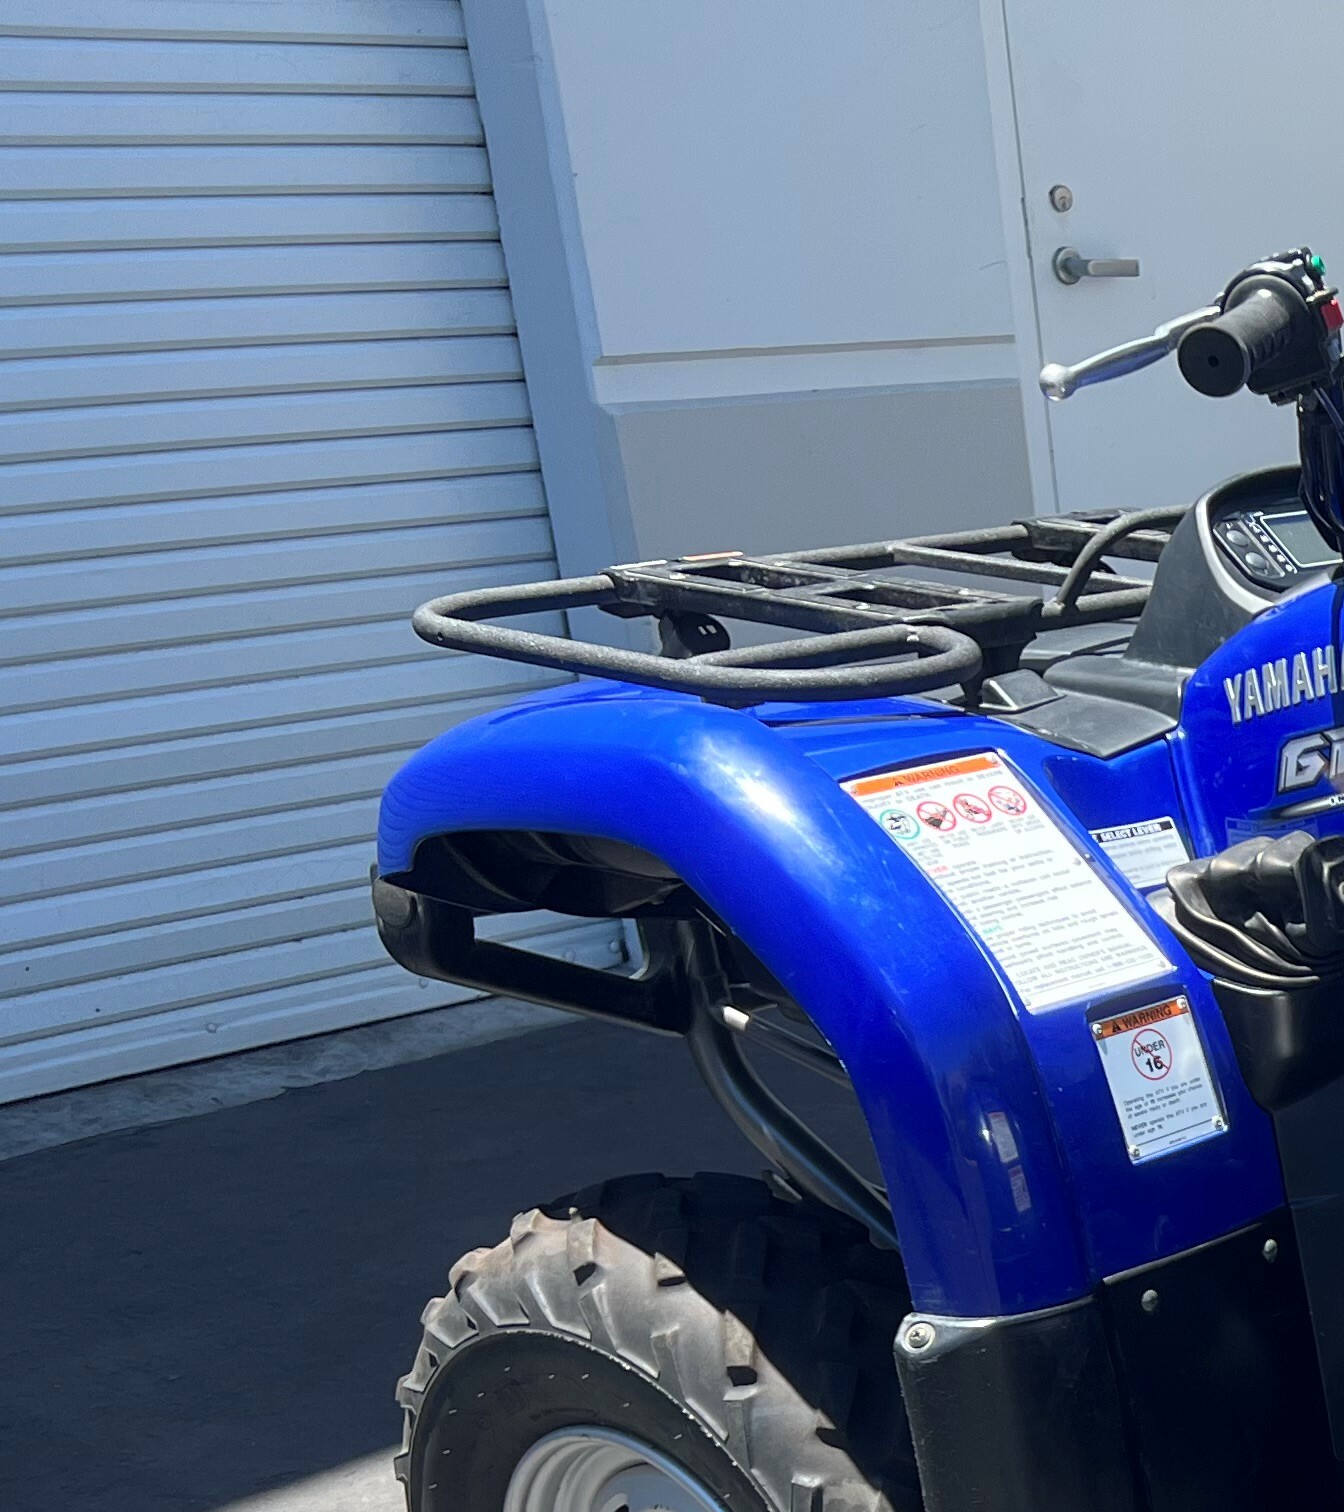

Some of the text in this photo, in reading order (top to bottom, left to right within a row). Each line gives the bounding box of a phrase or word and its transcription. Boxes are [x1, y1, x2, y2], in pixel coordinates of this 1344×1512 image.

[904, 765, 960, 782] WARNING
[1101, 829, 1132, 842] SELECT
[1133, 823, 1162, 837] LEVER
[1122, 1004, 1172, 1029] WARNING
[1134, 1039, 1166, 1057] UNDER
[1145, 1056, 1165, 1072] 16
